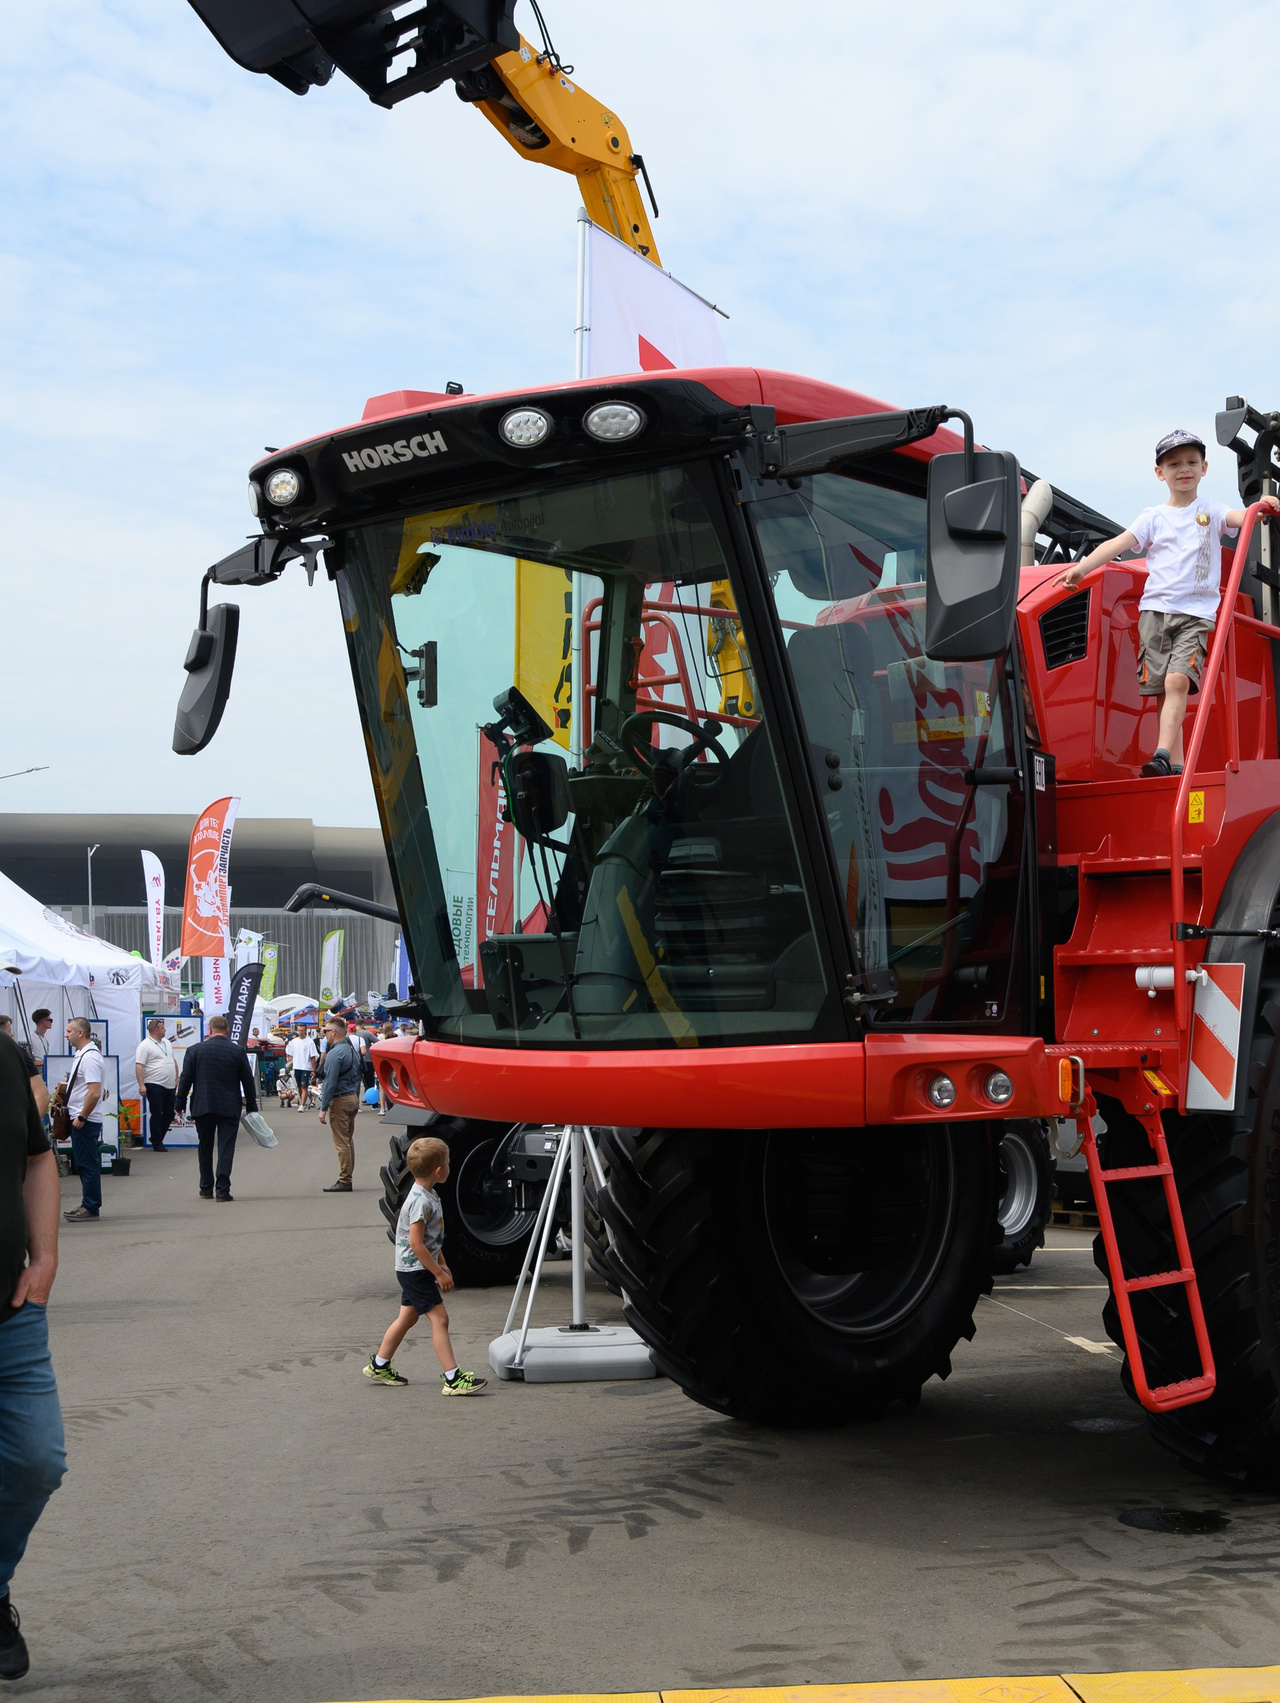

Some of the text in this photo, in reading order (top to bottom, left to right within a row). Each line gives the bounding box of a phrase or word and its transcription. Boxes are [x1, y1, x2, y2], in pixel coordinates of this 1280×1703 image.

[342, 430, 448, 473] HORSCH
[443, 512, 545, 544] Trimble Autopilot
[212, 958, 223, 1005] MM-SHN
[236, 976, 252, 1012] ПАРК
